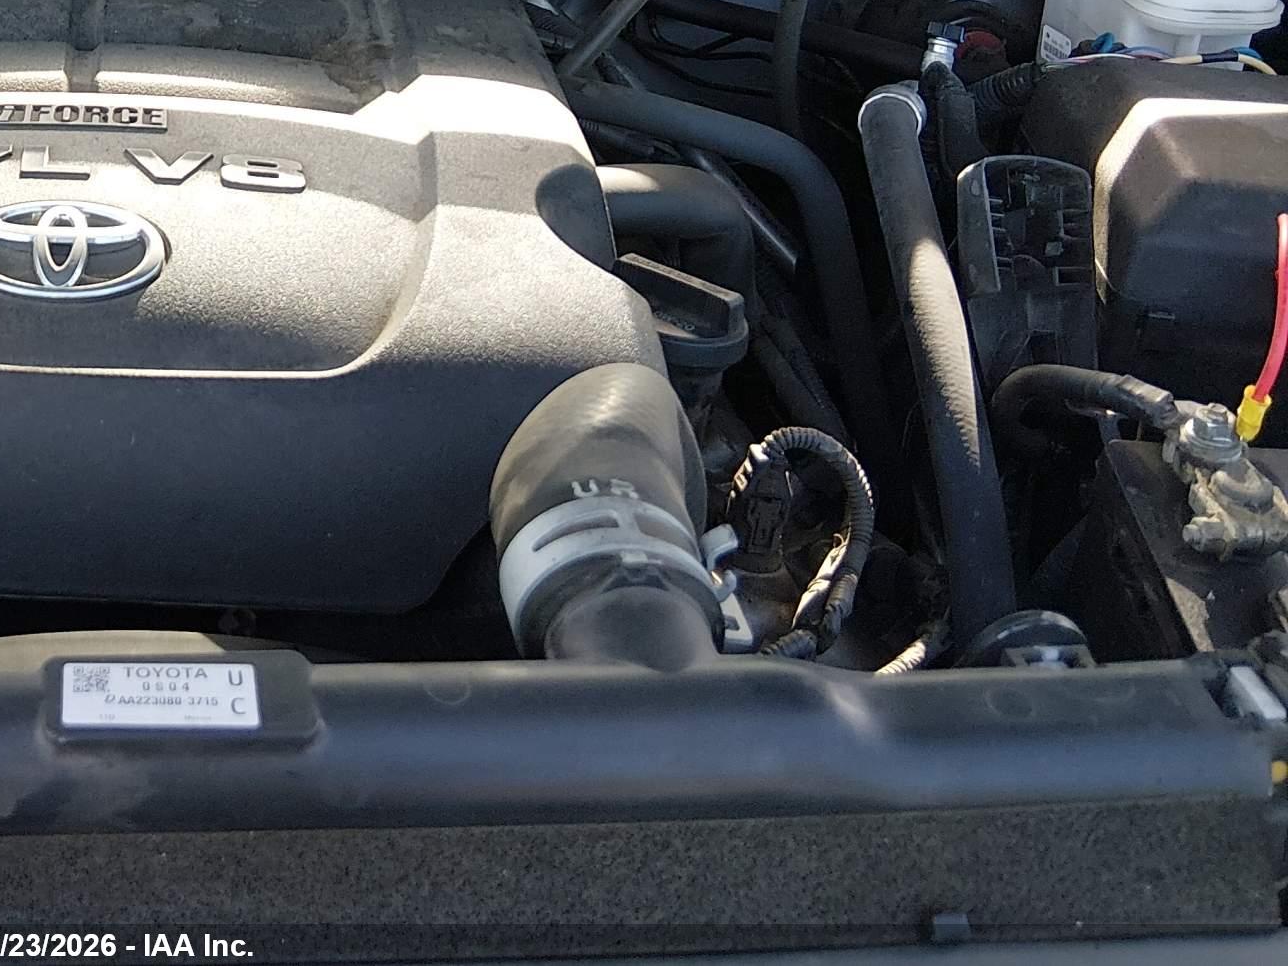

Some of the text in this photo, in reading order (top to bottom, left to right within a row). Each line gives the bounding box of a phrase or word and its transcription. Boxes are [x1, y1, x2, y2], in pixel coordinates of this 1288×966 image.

[125, 147, 307, 193] V8
[124, 666, 208, 679] TOYOTA
[227, 669, 244, 687] U
[230, 697, 247, 715] C
